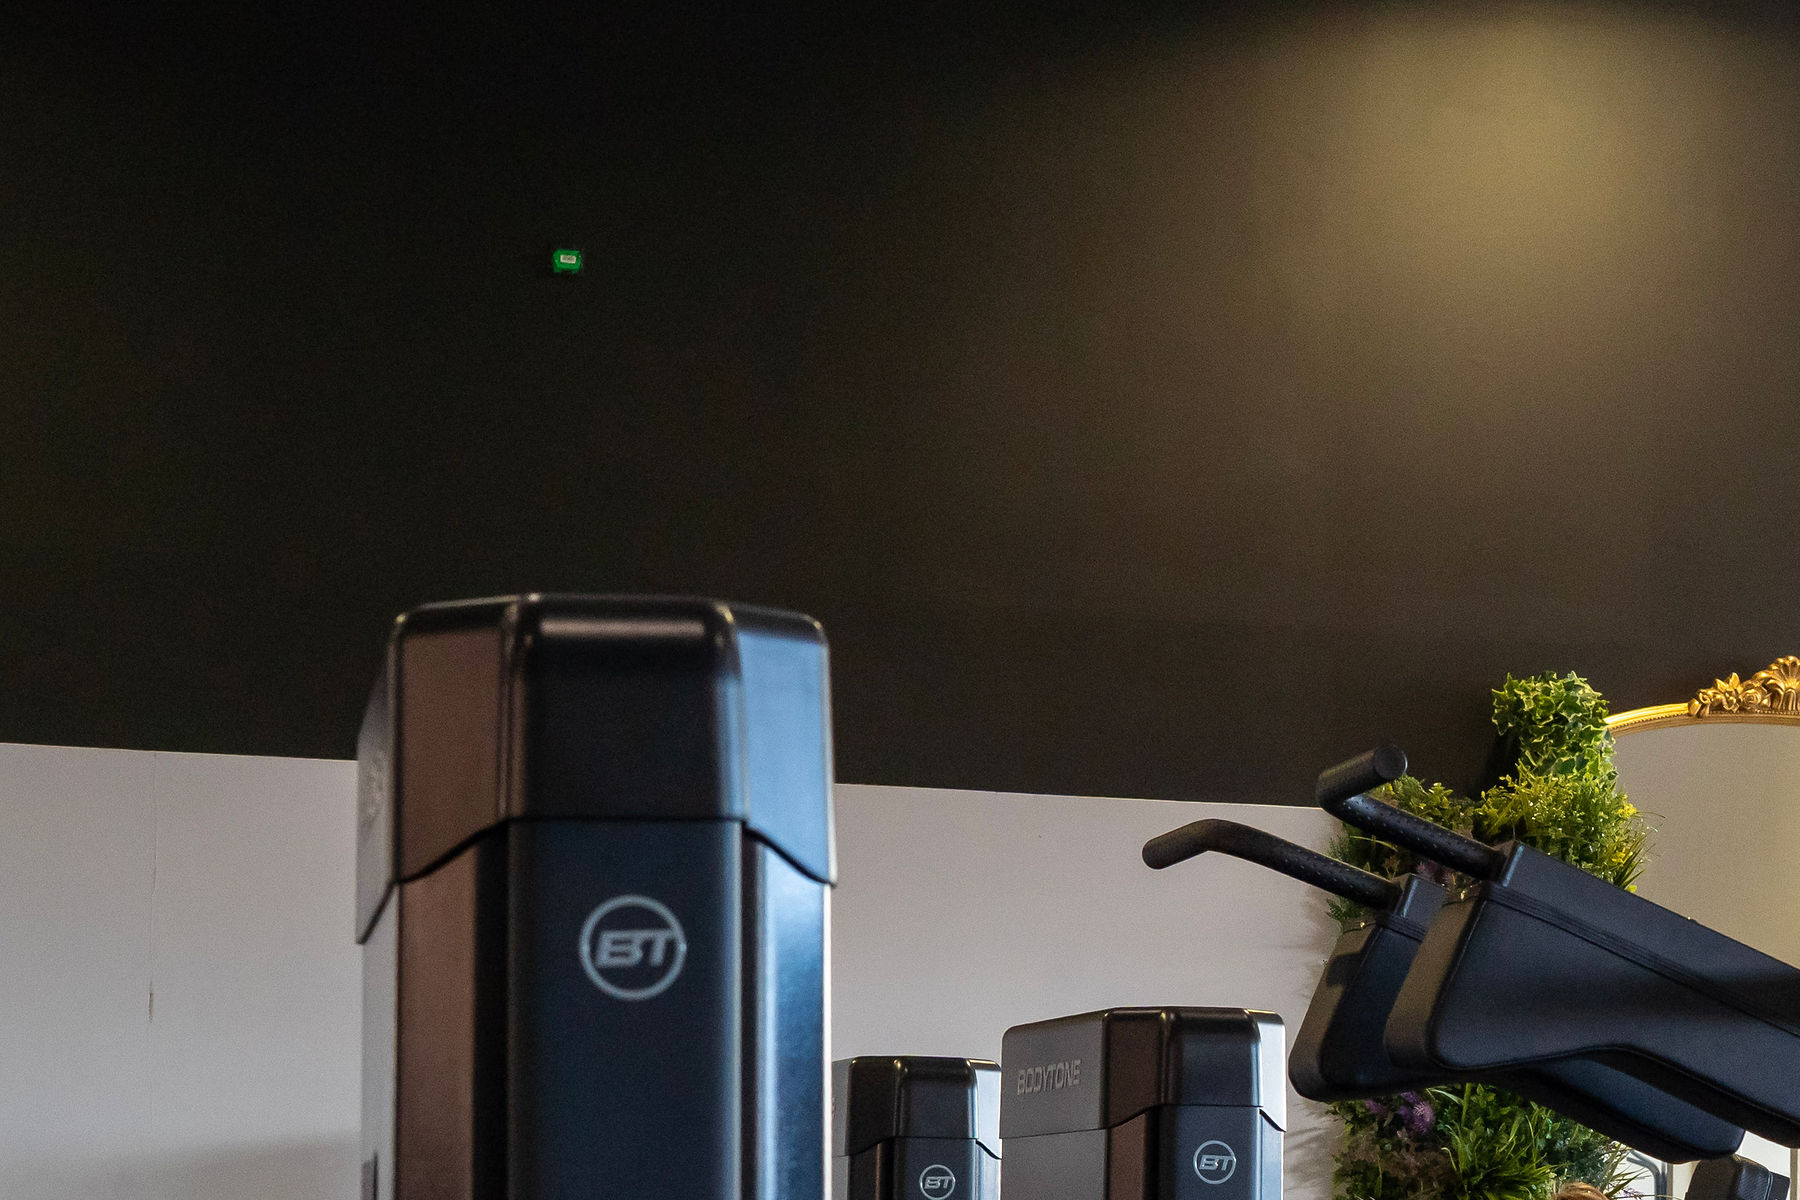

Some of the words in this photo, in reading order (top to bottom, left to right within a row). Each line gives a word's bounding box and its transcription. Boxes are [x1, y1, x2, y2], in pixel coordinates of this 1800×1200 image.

[596, 928, 676, 968] BT
[1016, 1059, 1082, 1096] BODYTONE
[1199, 1154, 1236, 1171] BT
[923, 1175, 954, 1190] BT
